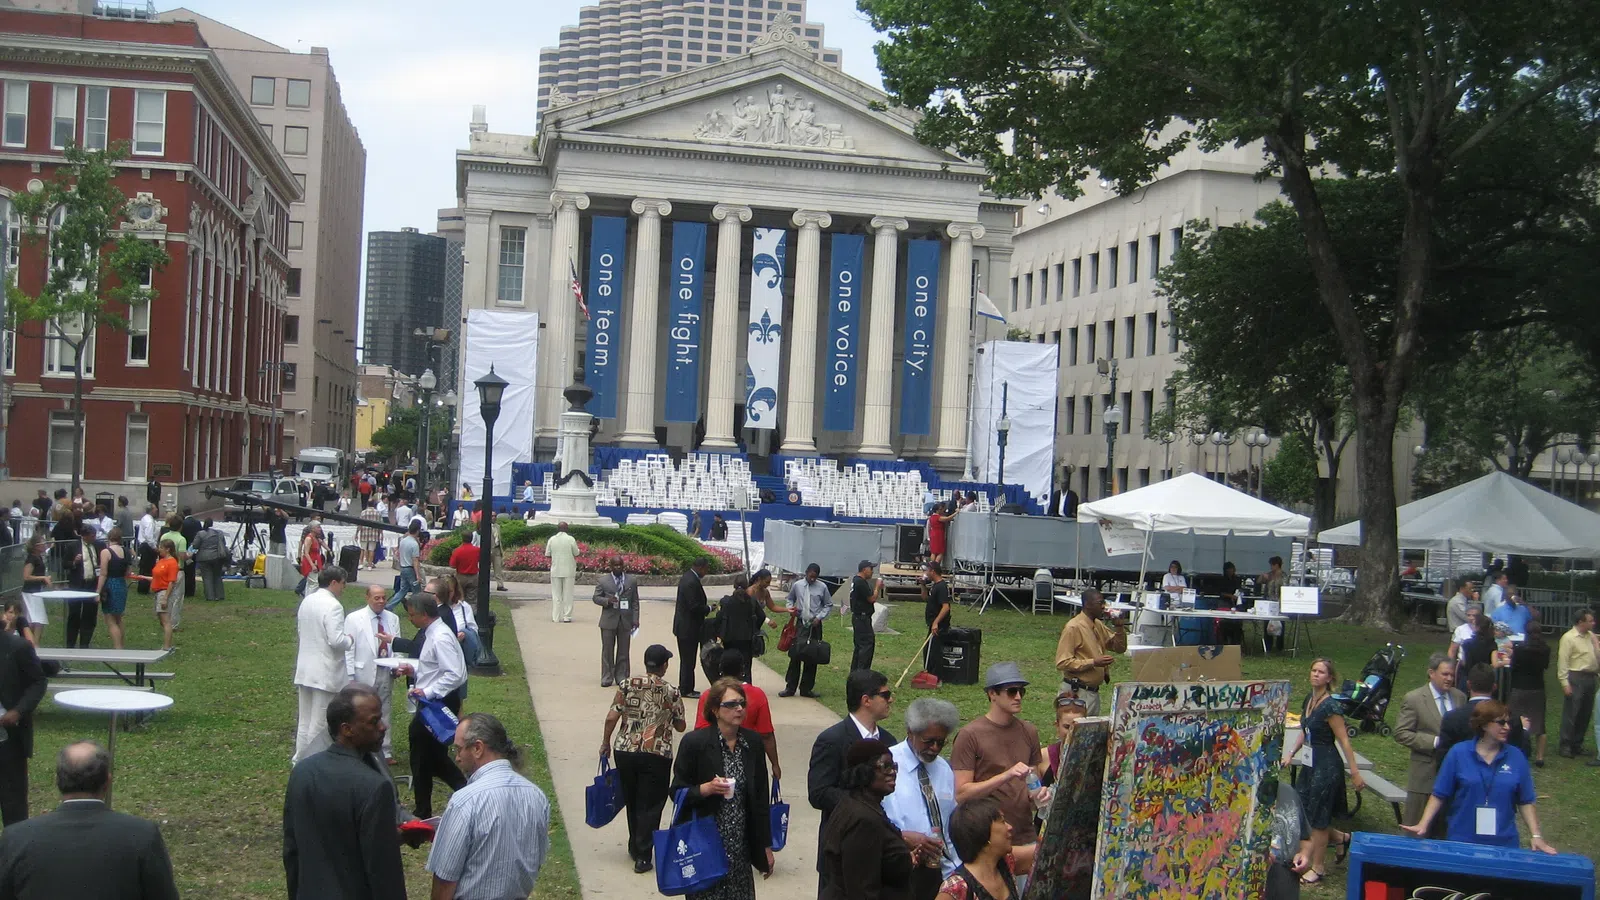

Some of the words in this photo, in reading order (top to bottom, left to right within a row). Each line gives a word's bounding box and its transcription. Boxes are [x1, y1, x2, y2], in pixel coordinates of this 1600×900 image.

[598, 253, 613, 296] one
[679, 257, 694, 300] one
[838, 270, 852, 312] one
[914, 276, 929, 317] one
[593, 309, 614, 374] team.
[671, 312, 700, 370] fight.
[833, 324, 854, 393] voice.
[906, 329, 930, 376] city.
